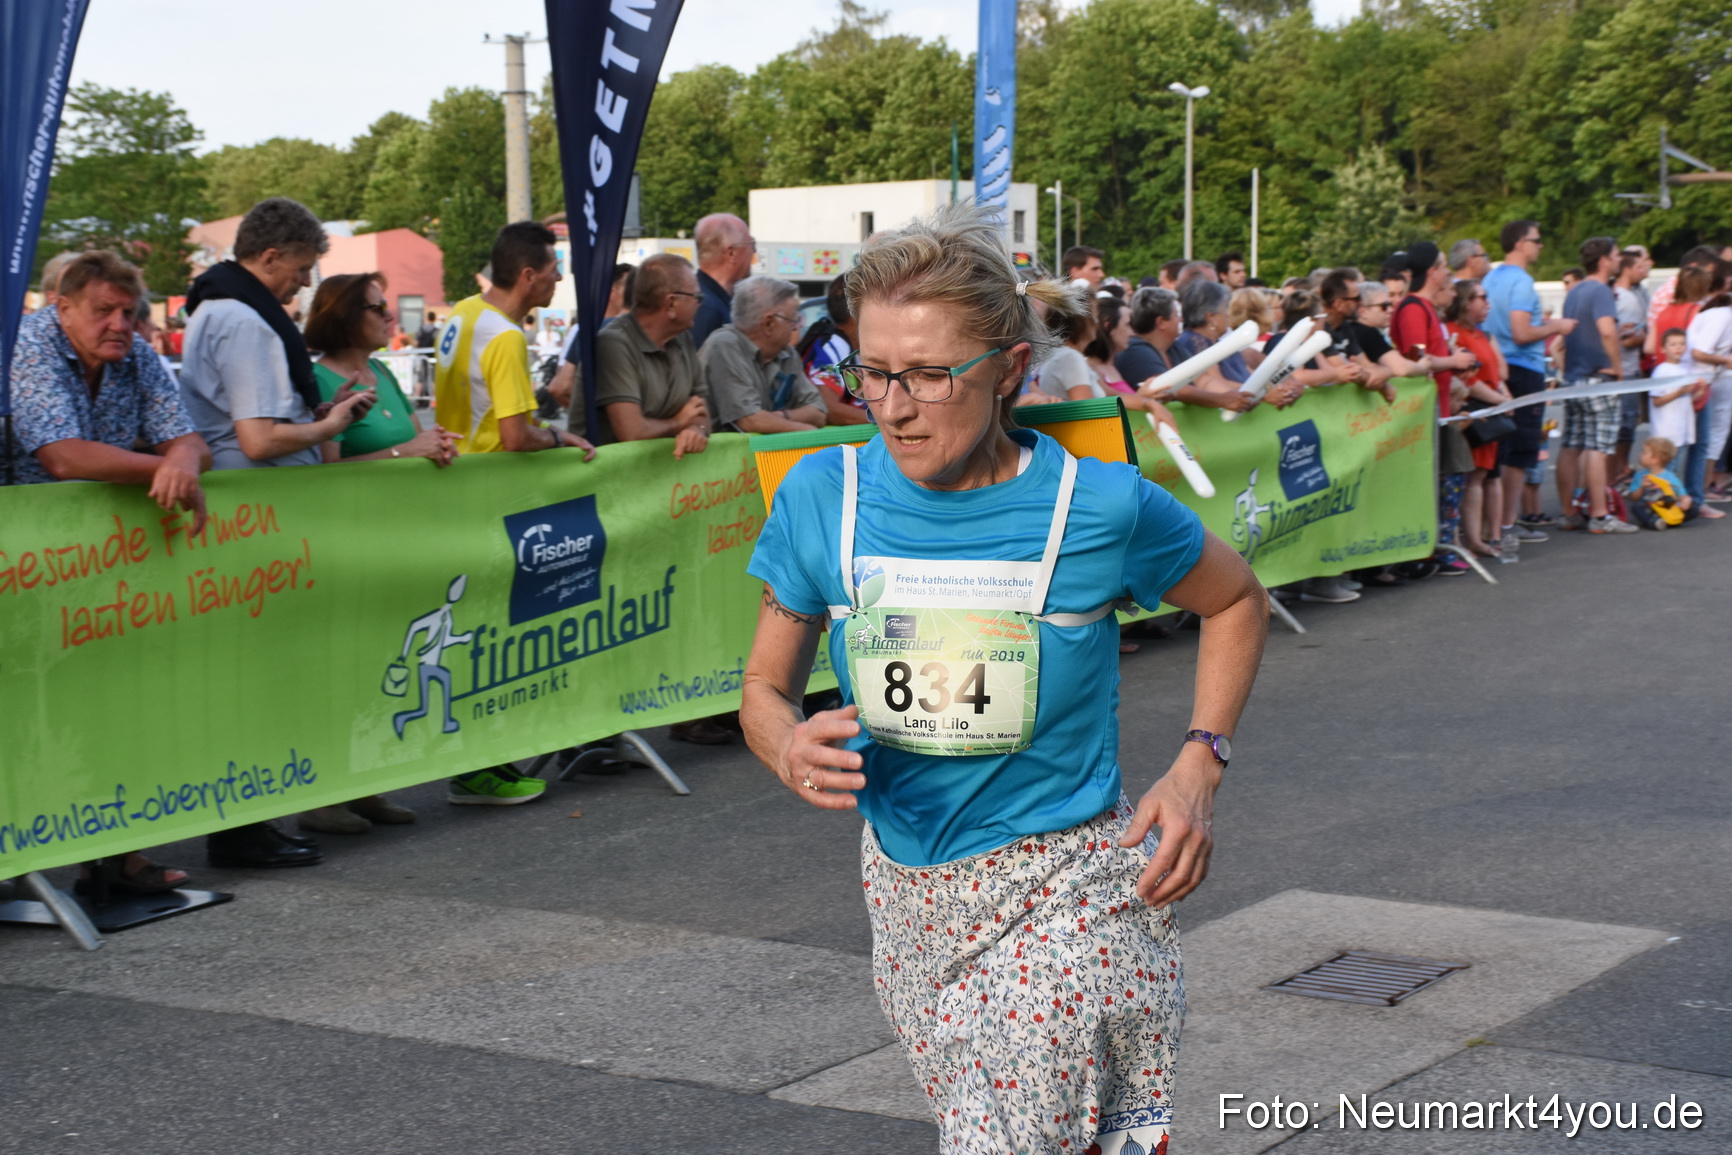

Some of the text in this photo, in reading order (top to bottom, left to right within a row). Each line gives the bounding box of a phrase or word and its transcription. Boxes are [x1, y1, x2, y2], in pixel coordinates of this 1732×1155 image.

[159, 503, 281, 557] Firmen
[532, 534, 594, 565] Fischer
[894, 585, 905, 594] im
[906, 586, 926, 596] Haus
[896, 573, 1034, 587] Freie katholische Volksschule
[61, 538, 316, 650] laufen länger!
[470, 565, 677, 694] firmenlauf
[871, 634, 945, 651] firmenlauf
[989, 650, 1025, 662] 2019
[473, 668, 570, 721] neumarkt
[884, 661, 991, 714] 834
[881, 727, 912, 737] Katholische
[912, 731, 954, 739] Volksschule
[904, 715, 969, 731] Lang Lilo
